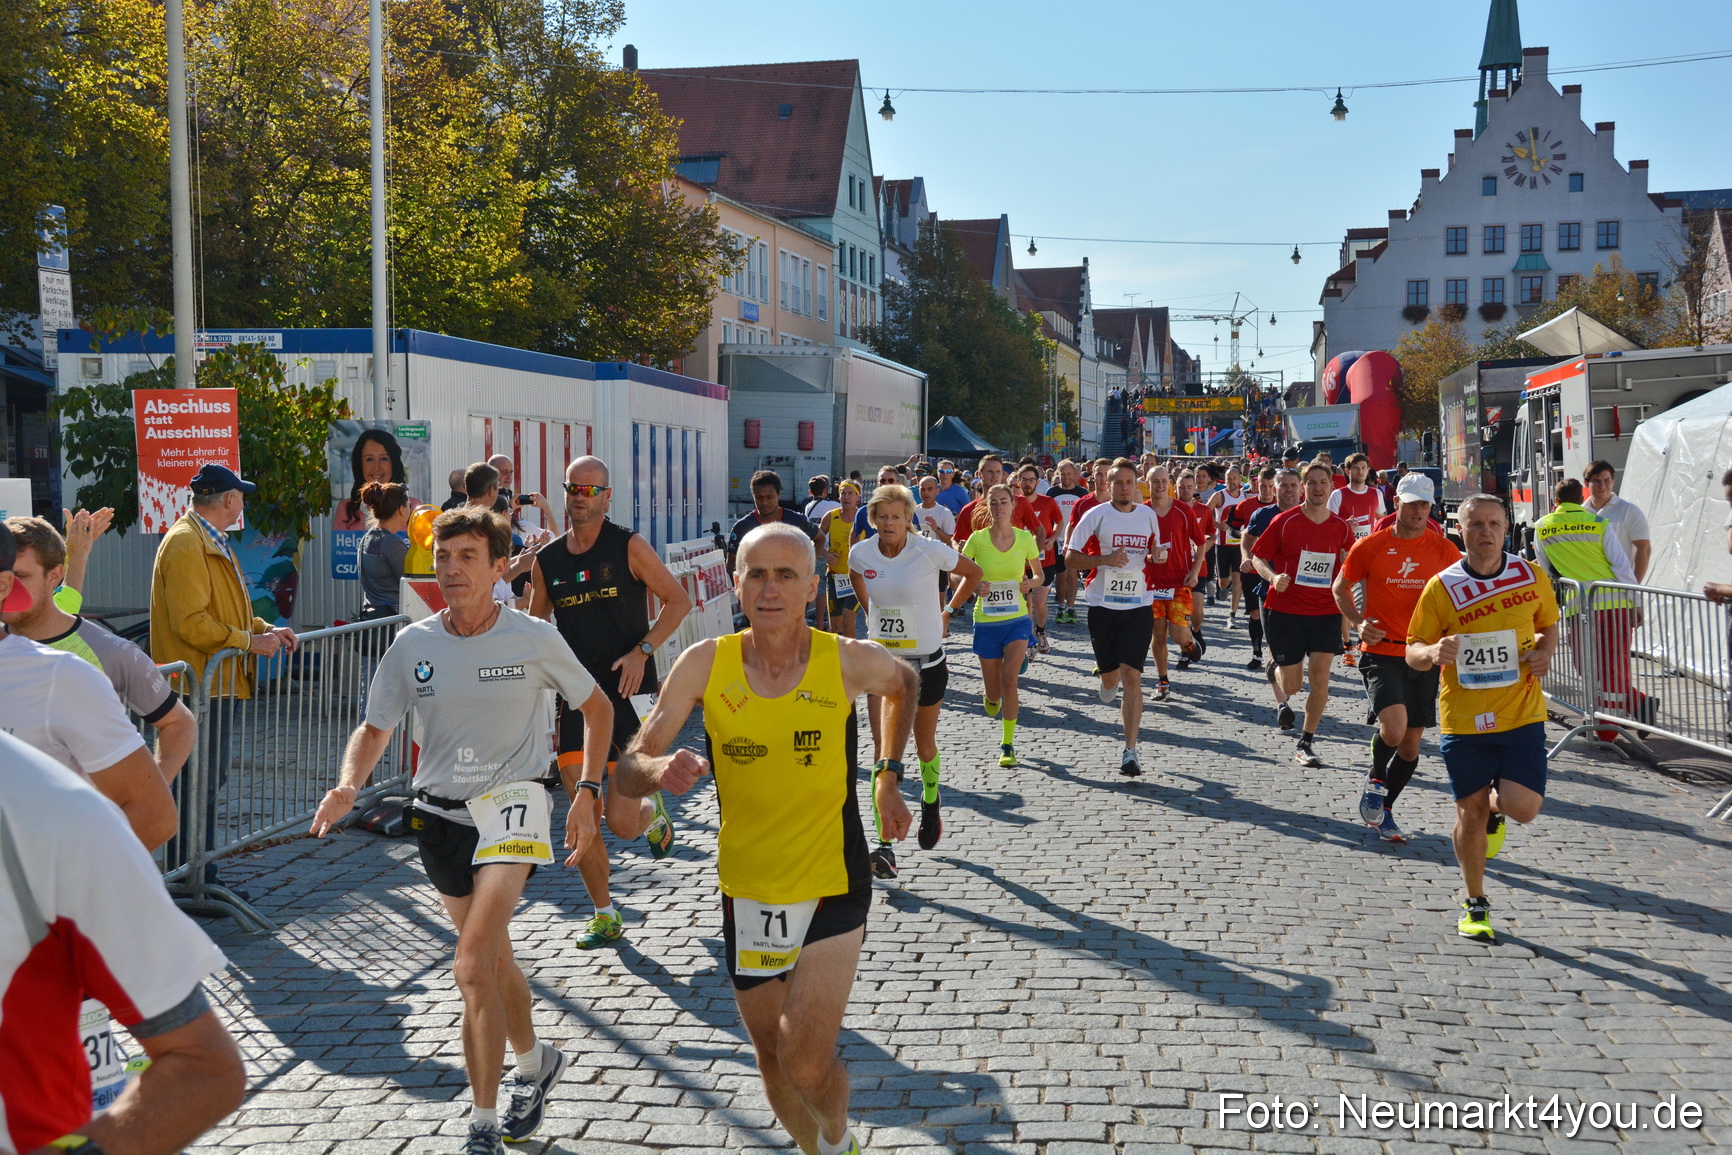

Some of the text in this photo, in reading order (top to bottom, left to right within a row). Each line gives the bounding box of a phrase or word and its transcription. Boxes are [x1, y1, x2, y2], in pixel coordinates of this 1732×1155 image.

[42, 284, 69, 296] Parkschein
[45, 296, 68, 307] werktags
[144, 398, 230, 414] Abschluss
[1176, 400, 1212, 409] START
[144, 416, 173, 424] statt
[145, 426, 232, 439] Ausschluss!
[161, 447, 229, 457] Mehr Lehrer für
[158, 458, 230, 467] kleinere Klassen.
[1542, 524, 1596, 535] Org.-Leiter
[1114, 536, 1146, 547] REWE
[336, 564, 357, 574] CSU
[1304, 561, 1330, 573] 2467
[1110, 580, 1138, 591] 2147
[987, 590, 1013, 601] 2616
[1458, 590, 1540, 626] MAX BÖGL
[880, 618, 904, 633] 273
[1470, 636, 1498, 645] BOCK
[1464, 646, 1508, 665] 2415
[479, 665, 525, 678] BOCK
[1474, 673, 1503, 682] Michael
[794, 730, 821, 746] MTP
[457, 748, 479, 762] 19.
[493, 789, 528, 805] BOCK
[500, 804, 527, 831] 77
[499, 843, 533, 854] Herbert
[760, 910, 787, 938] 71
